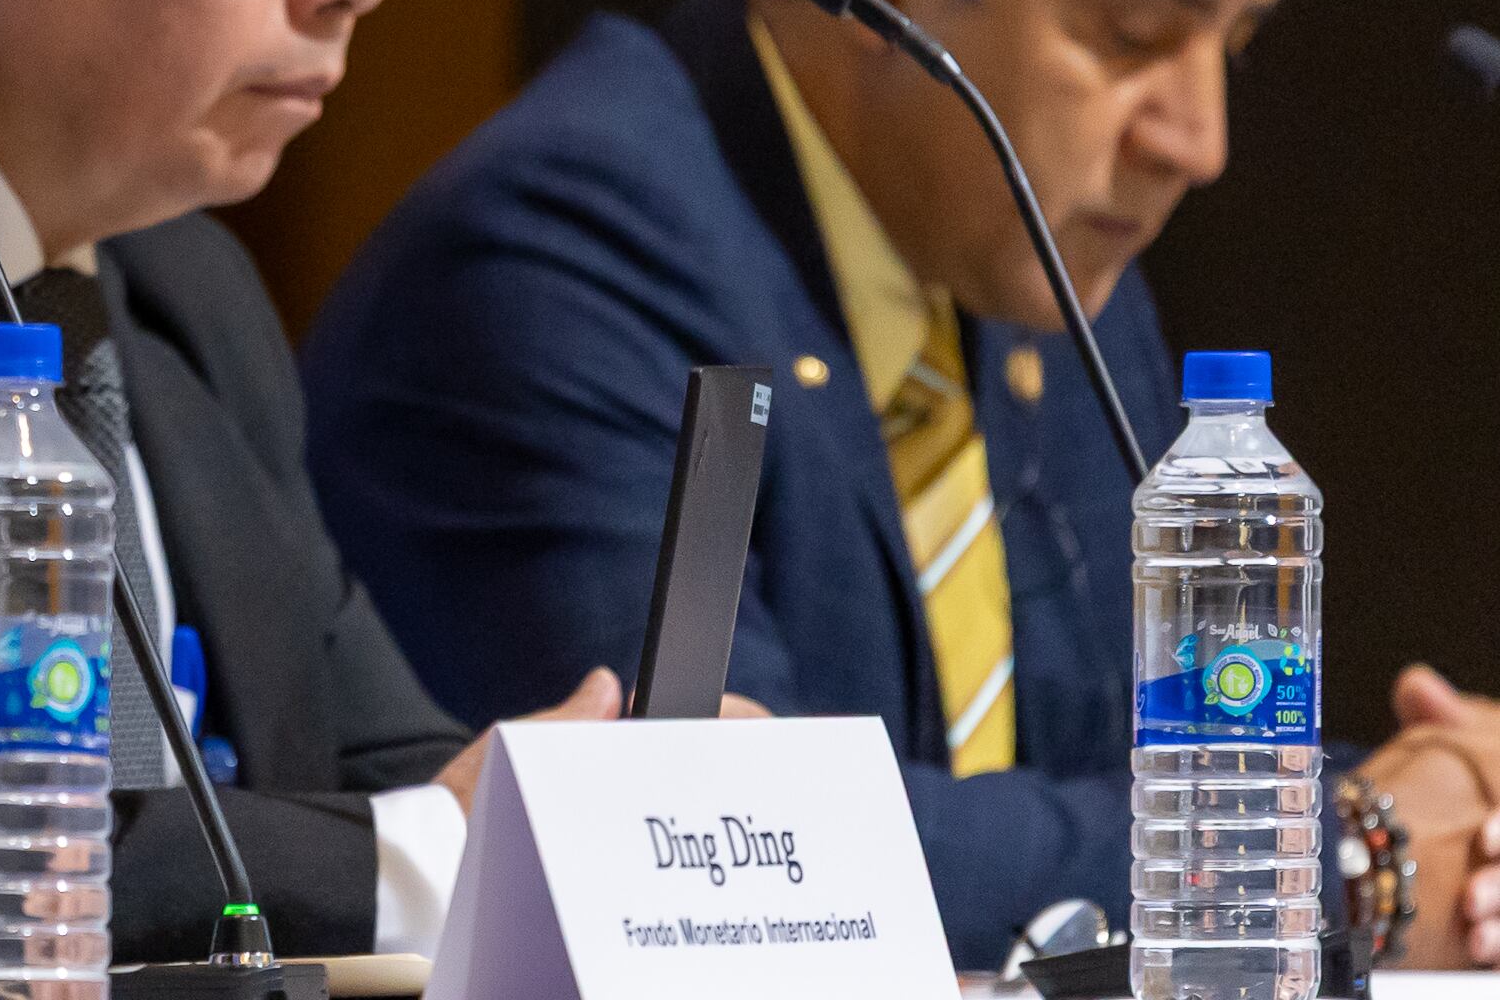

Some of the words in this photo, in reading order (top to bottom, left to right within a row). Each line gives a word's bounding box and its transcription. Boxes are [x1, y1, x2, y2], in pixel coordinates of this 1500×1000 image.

[1276, 685, 1307, 700] 50%
[1275, 710, 1307, 724] 100%
[645, 816, 726, 886] Ding
[721, 815, 804, 883] Ding
[623, 917, 678, 946] Fondo
[678, 916, 763, 945] Monetario
[763, 911, 877, 943] Internacional
